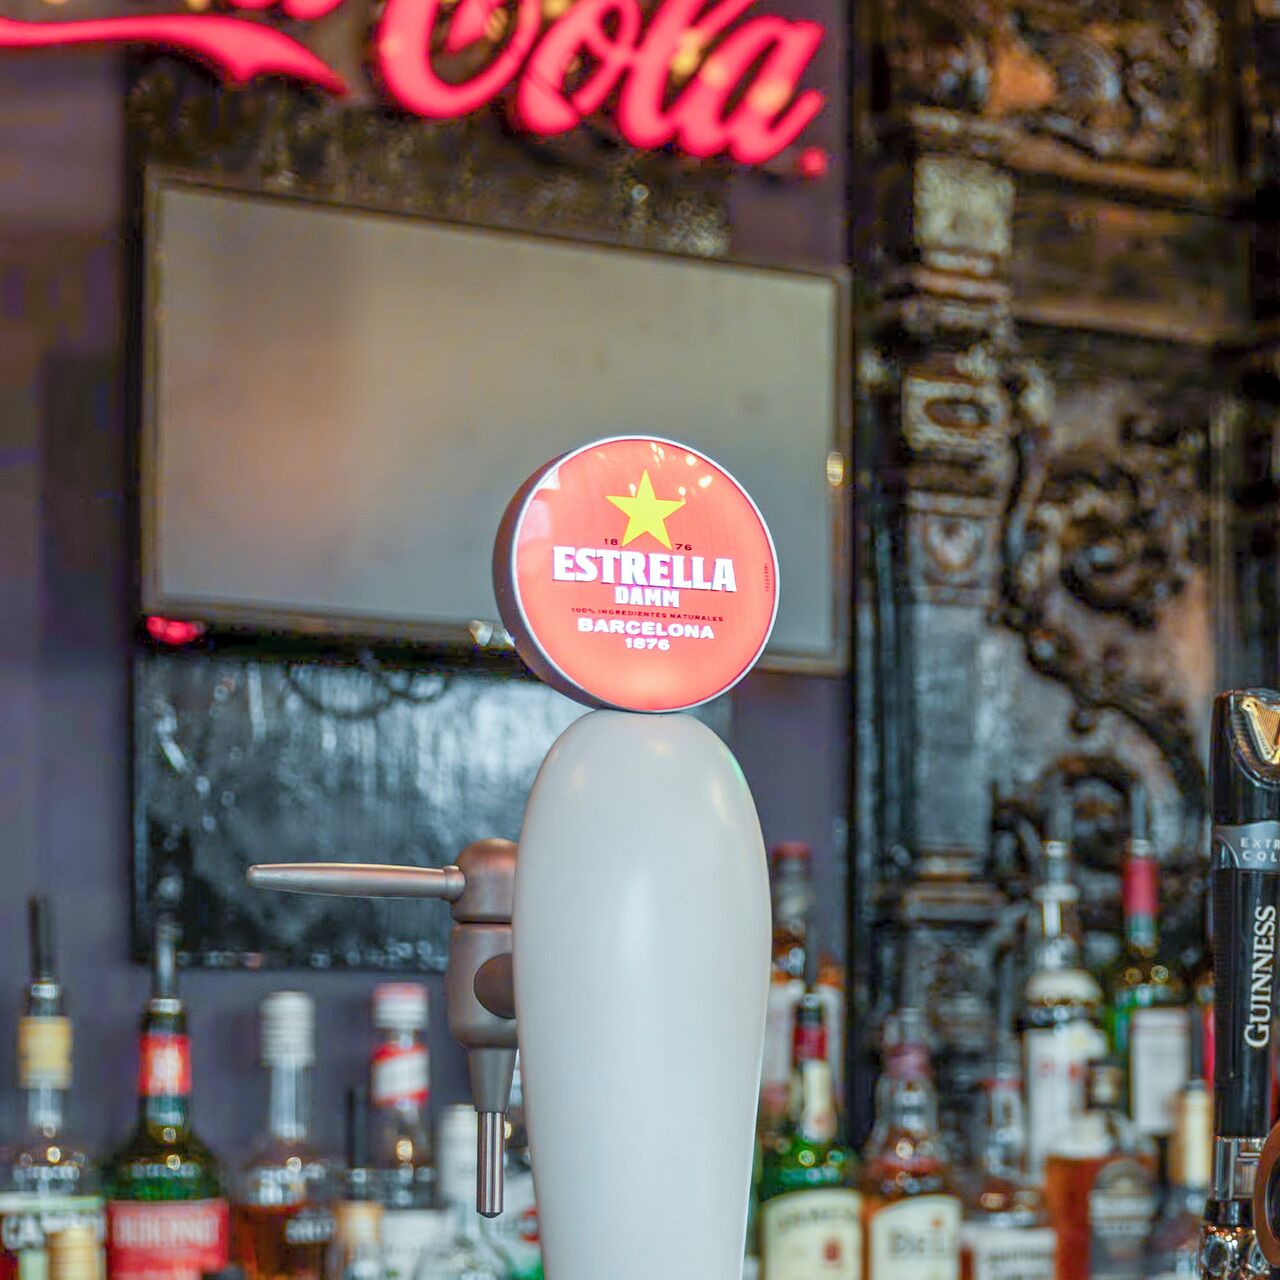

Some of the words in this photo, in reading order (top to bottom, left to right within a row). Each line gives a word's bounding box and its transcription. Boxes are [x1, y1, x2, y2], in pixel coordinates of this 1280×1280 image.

[552, 546, 737, 592] ESTRELLA
[614, 586, 680, 608] DAMM
[598, 609, 667, 619] INGREDIENTES
[669, 613, 724, 622] NATURALES
[577, 617, 715, 640] BARCELONA
[625, 637, 671, 651] 1876
[1243, 904, 1277, 1050] GUINNESS
